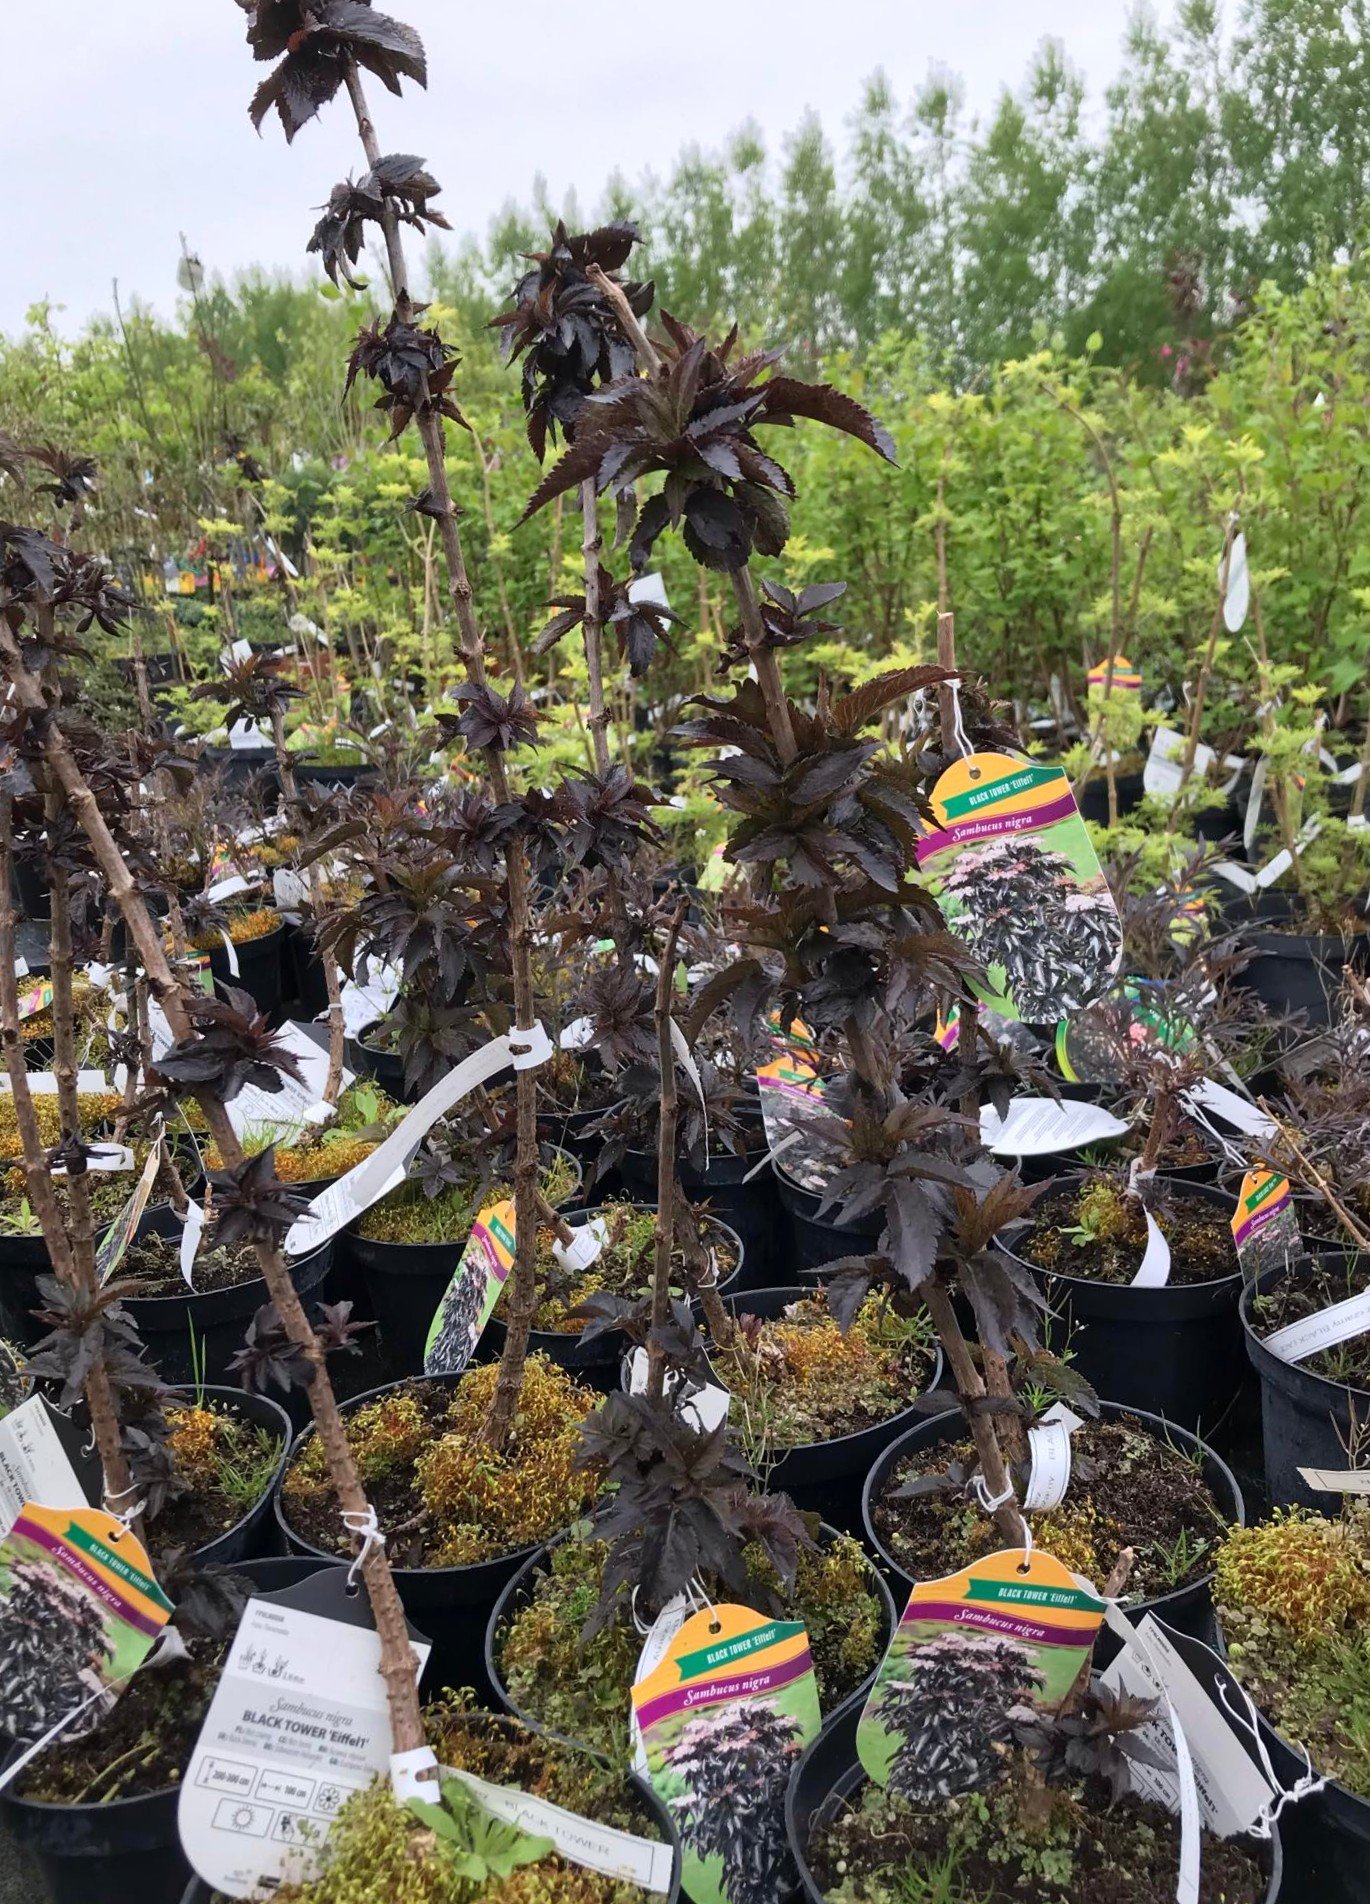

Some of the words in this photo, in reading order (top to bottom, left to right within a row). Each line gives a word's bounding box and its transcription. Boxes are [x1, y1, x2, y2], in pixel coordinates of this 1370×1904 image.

[952, 821, 1002, 842] Sambucus
[1004, 816, 1032, 830] nigra
[52, 1545, 98, 1586] Sambucus
[98, 1584, 122, 1608] nigra
[998, 1587, 1022, 1599] BLACK
[1023, 1590, 1048, 1602] TOWER
[954, 1608, 1014, 1630] Sambucus
[1015, 1623, 1045, 1637] nigra
[707, 1649, 728, 1664] BLACK
[730, 1640, 751, 1656] TOWER
[683, 1682, 739, 1706] Sambucus
[742, 1676, 770, 1691] nigra
[242, 1710, 282, 1728] BLACK
[284, 1719, 327, 1739] TOWER
[270, 1697, 323, 1720] Sambucus
[325, 1711, 353, 1729] nigra
[555, 1826, 610, 1856] TOWER
